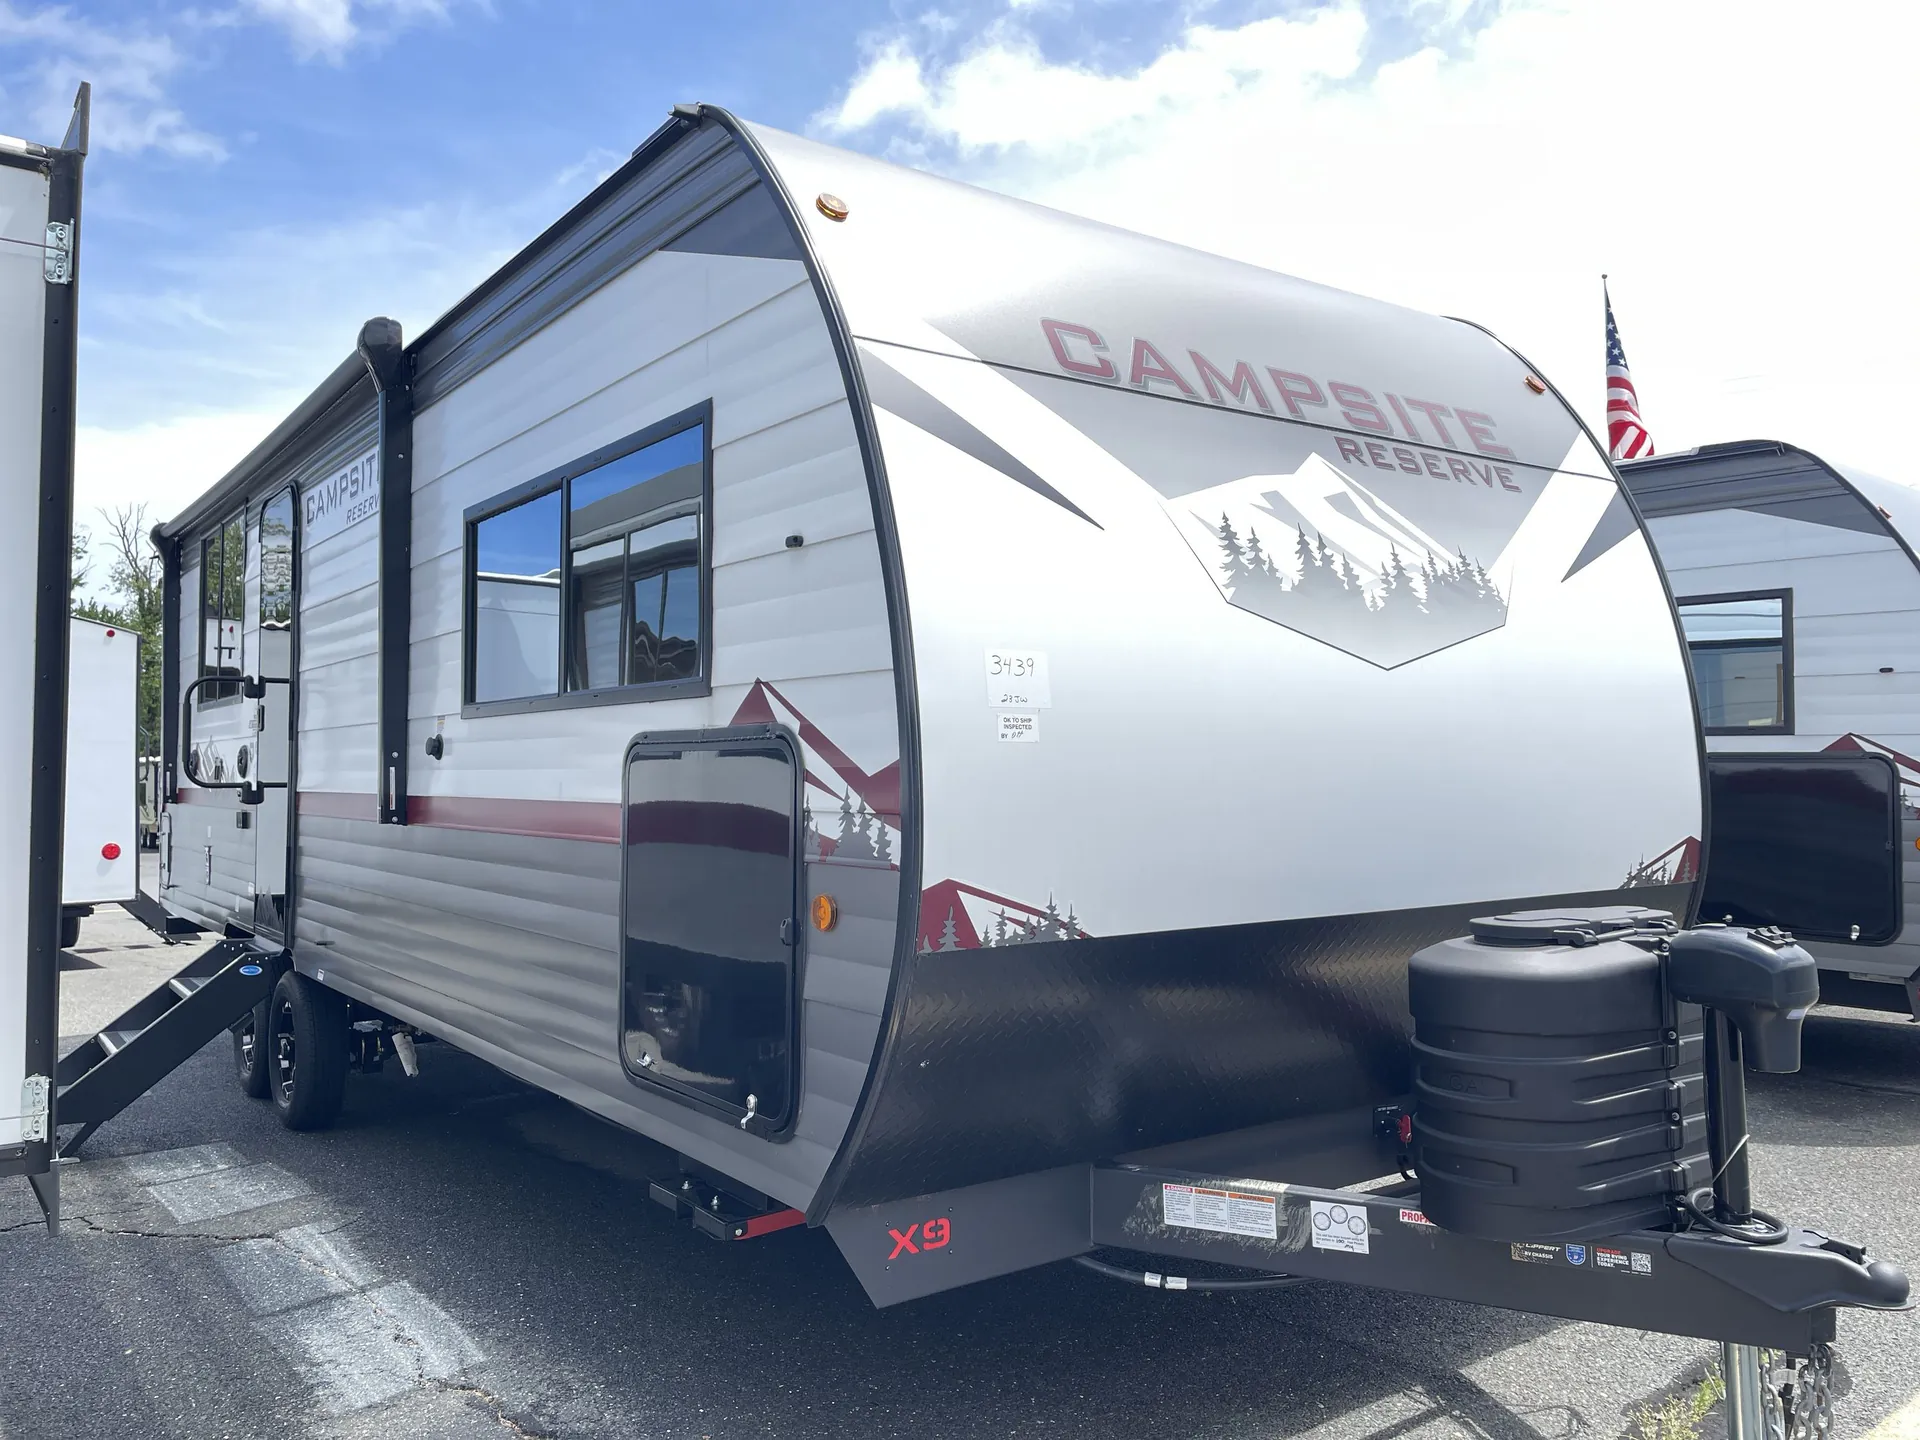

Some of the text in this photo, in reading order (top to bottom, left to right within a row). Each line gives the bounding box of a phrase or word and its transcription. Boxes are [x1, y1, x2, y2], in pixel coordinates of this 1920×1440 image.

[1040, 316, 1518, 461] CAMPSITE
[1334, 436, 1522, 492] RESERVE
[306, 450, 380, 525] CAMPSIT
[990, 654, 1034, 677] 3439
[1402, 1210, 1431, 1224] PROPA
[888, 1217, 951, 1260] X9
[1525, 1243, 1562, 1252] LIPPERT
[1596, 1257, 1629, 1265] EXPERIENCE
